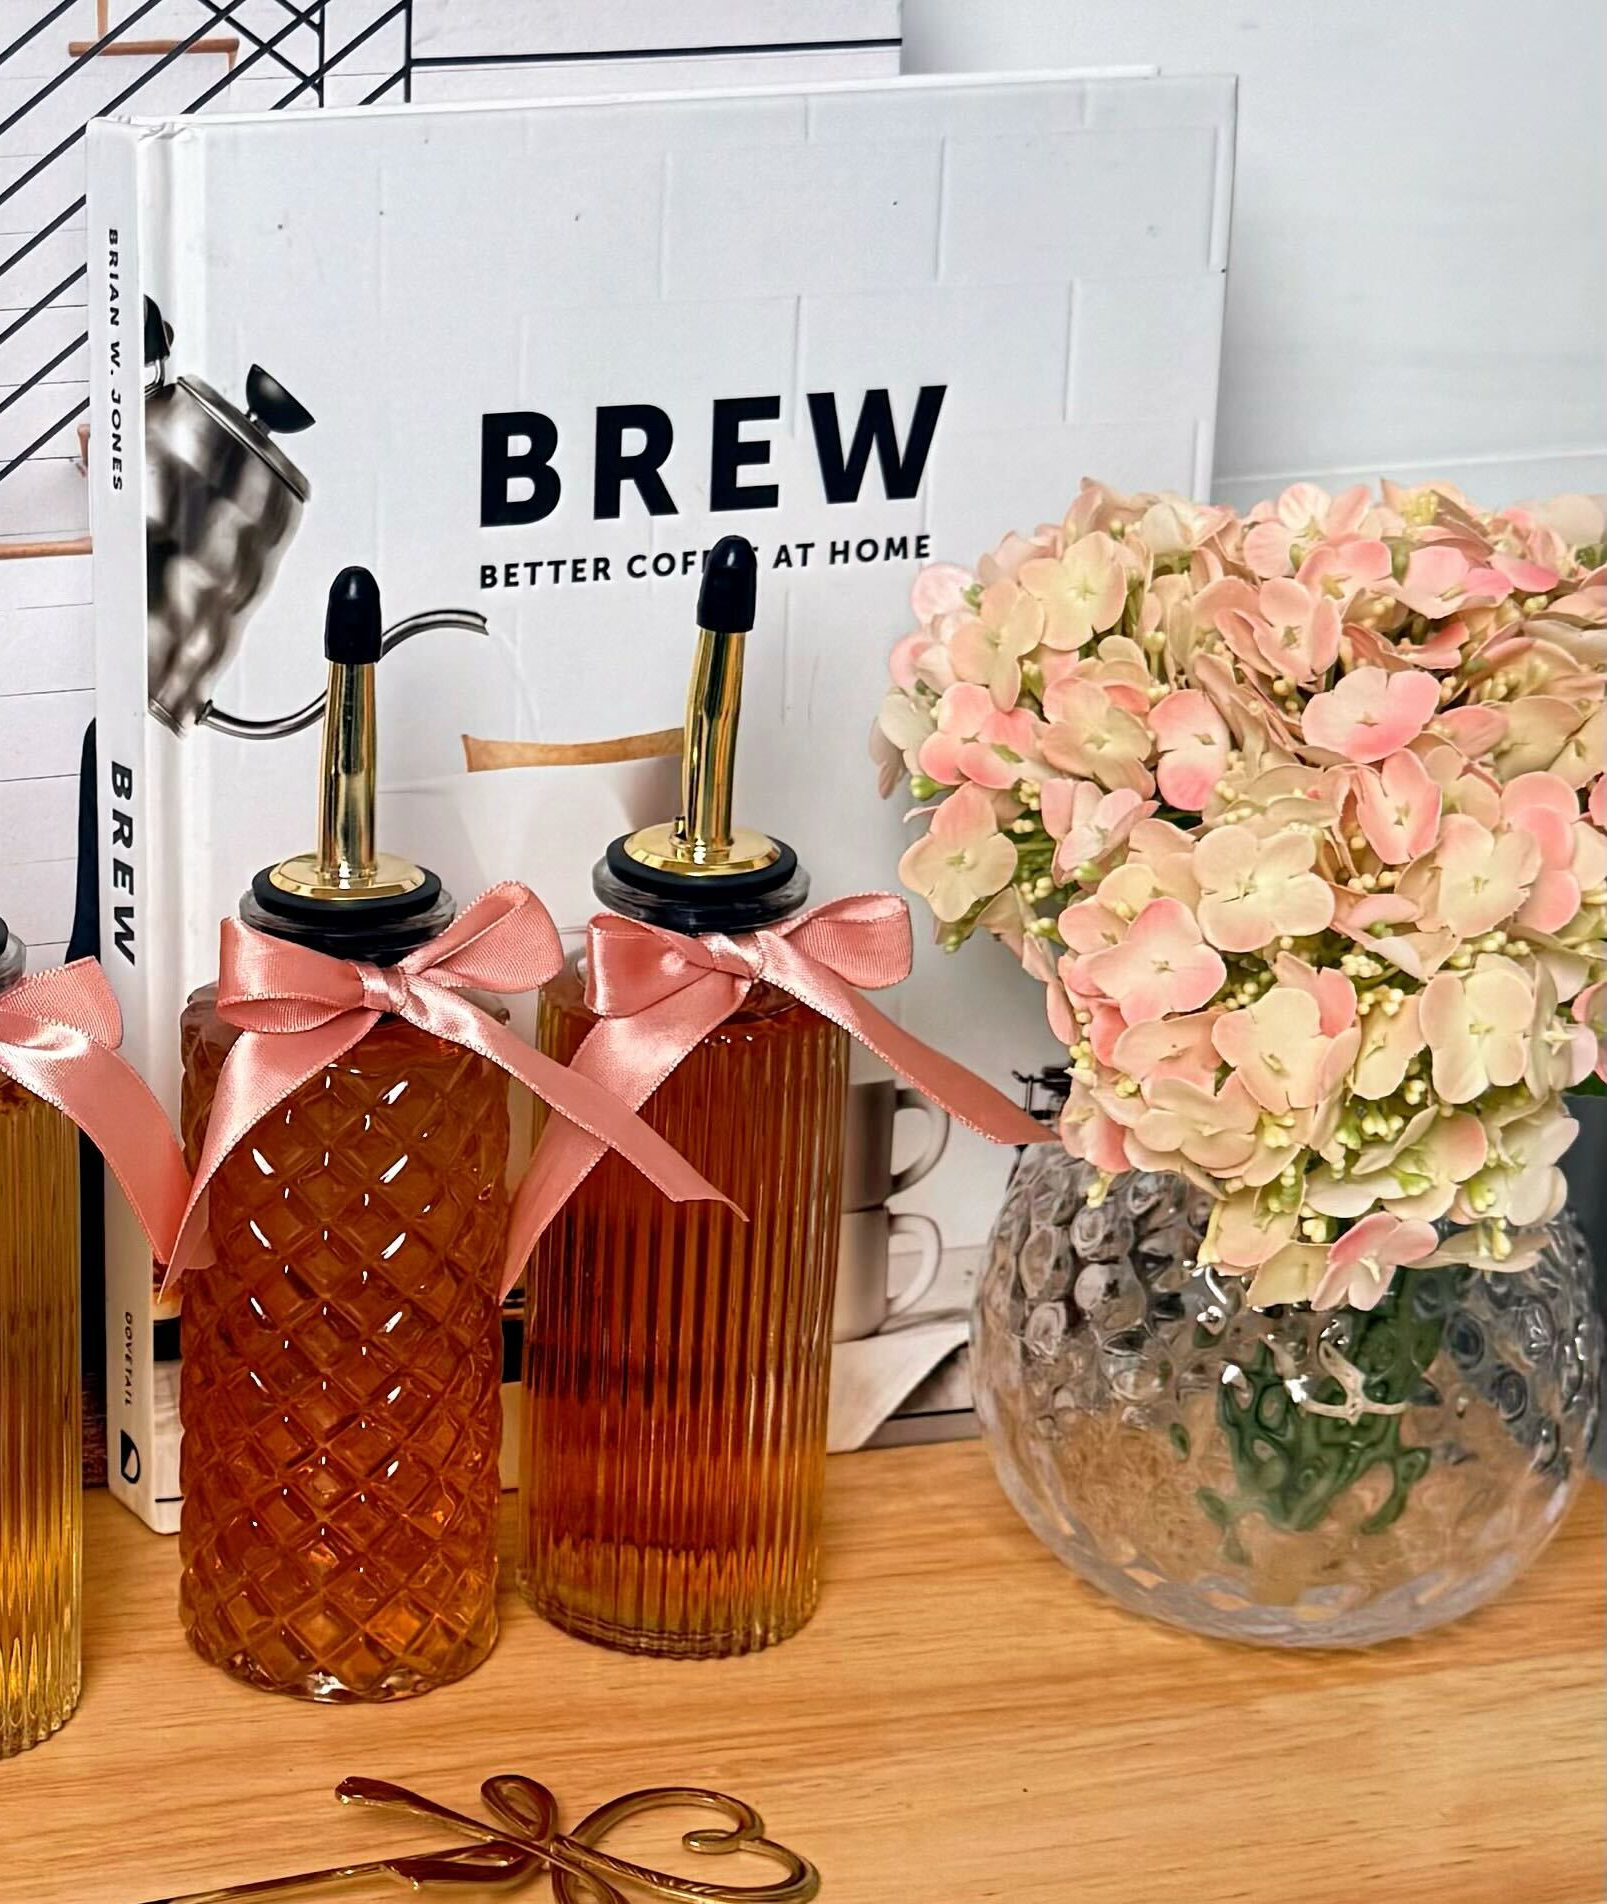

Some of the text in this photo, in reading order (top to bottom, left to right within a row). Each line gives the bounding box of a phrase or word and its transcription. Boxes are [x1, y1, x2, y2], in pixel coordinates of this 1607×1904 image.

[108, 228, 123, 491] BRIAN W. JONES
[480, 384, 948, 528] BREW
[480, 534, 931, 589] BETTER COF AT HOME
[111, 760, 136, 966] BREW
[124, 1311, 134, 1406] DOVETAIL
